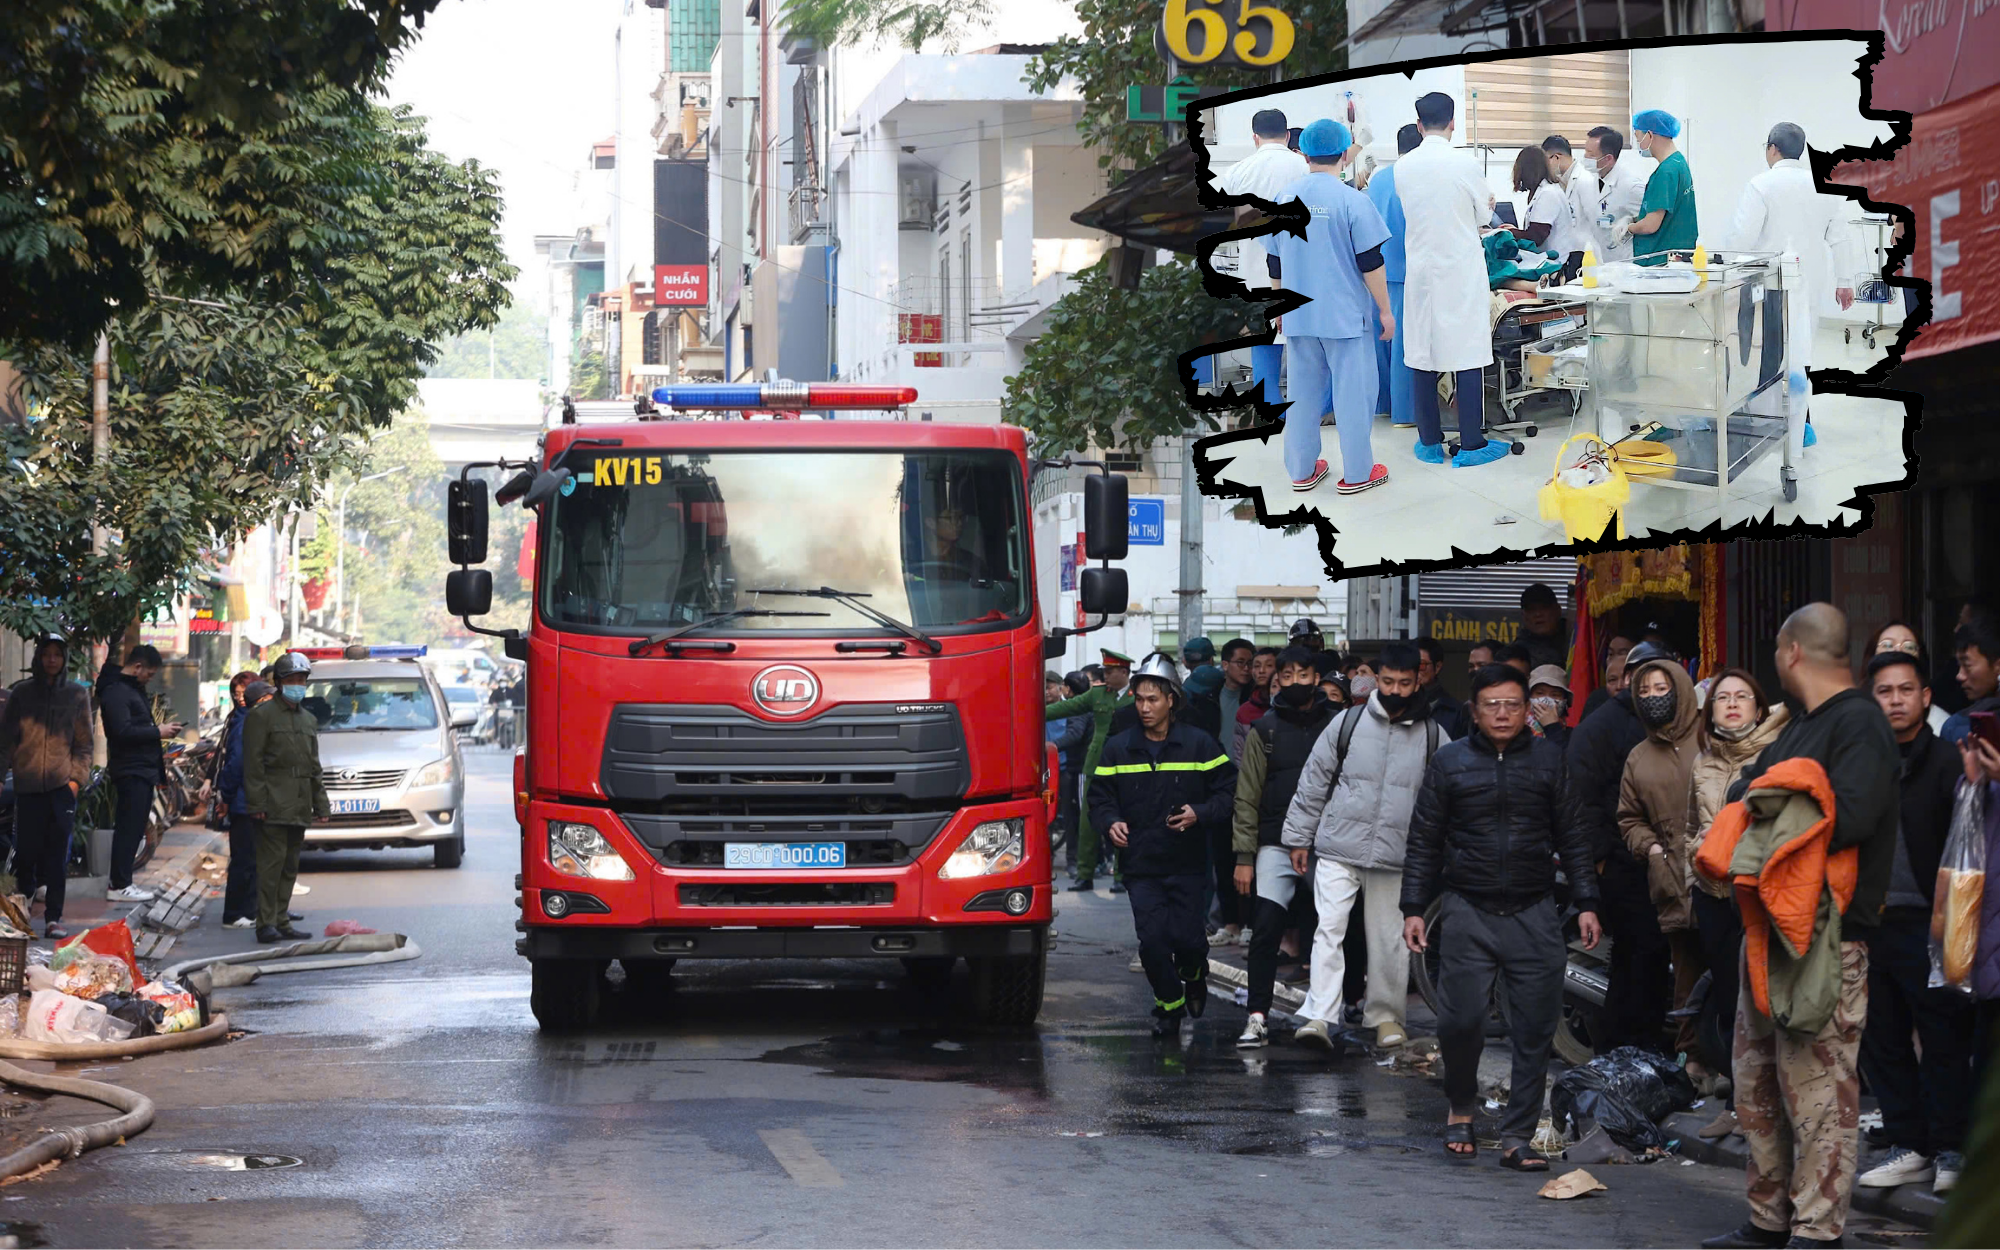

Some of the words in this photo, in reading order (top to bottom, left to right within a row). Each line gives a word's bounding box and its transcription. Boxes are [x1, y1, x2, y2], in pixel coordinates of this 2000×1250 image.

[1163, 0, 1295, 66] 65
[663, 271, 700, 285] NHẪN
[665, 288, 697, 299] CƯỚI
[594, 457, 662, 487] KV15
[1128, 521, 1139, 537] ĂN
[1142, 524, 1158, 540] THỤ
[1431, 613, 1480, 642] CẢNH
[1485, 617, 1519, 644] SÁT
[758, 679, 814, 702] UD
[330, 799, 378, 813] 9A-011.07
